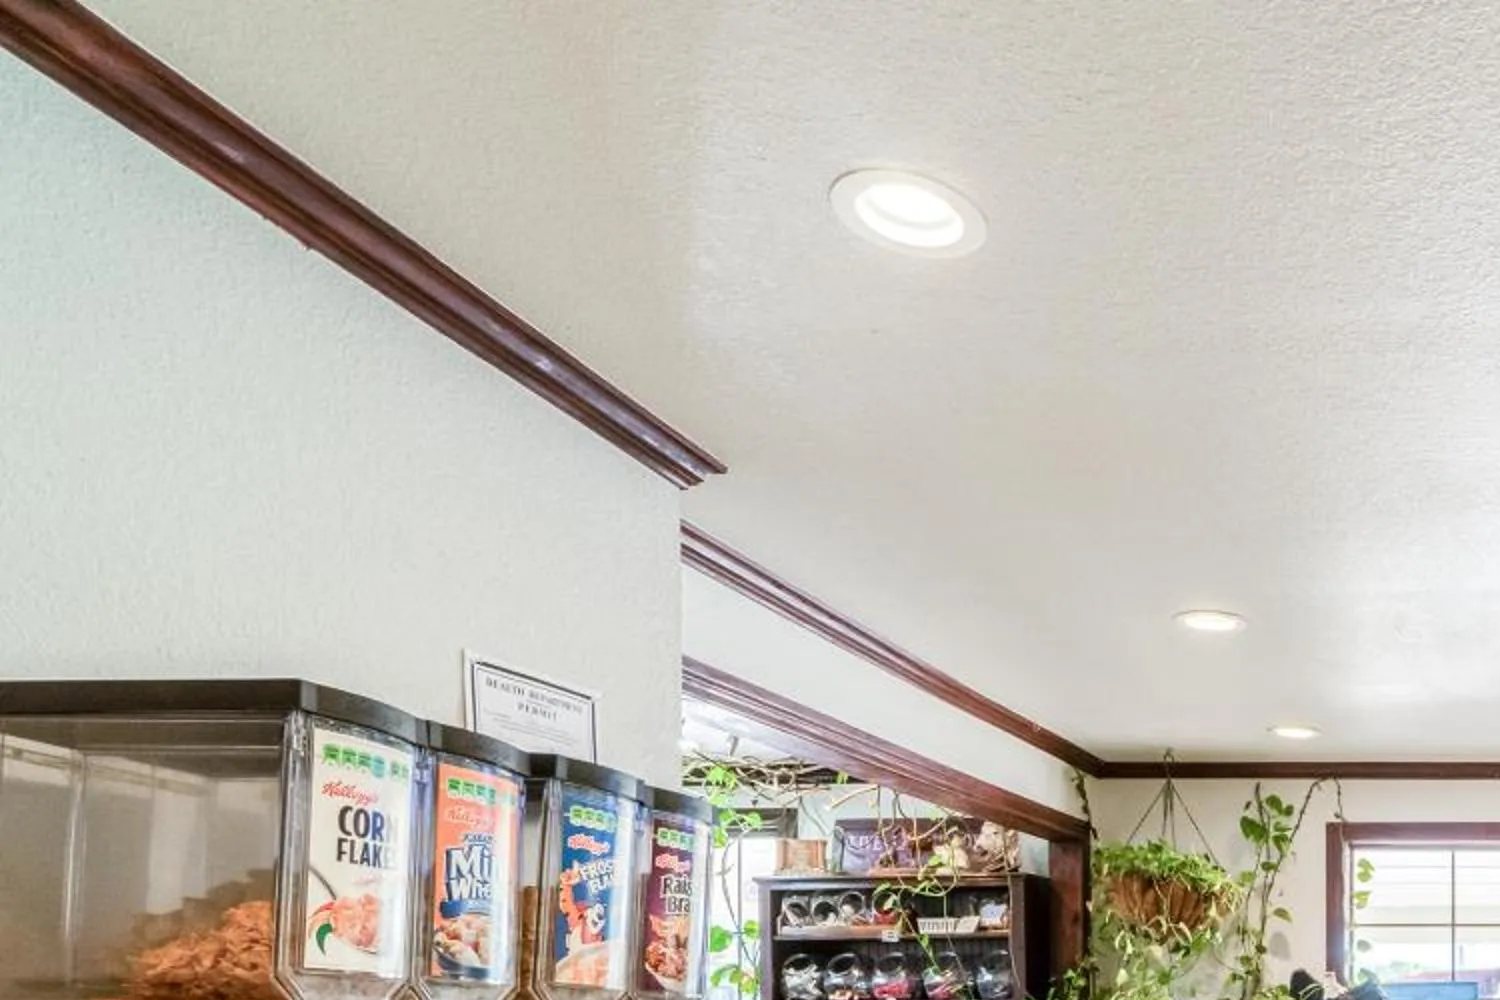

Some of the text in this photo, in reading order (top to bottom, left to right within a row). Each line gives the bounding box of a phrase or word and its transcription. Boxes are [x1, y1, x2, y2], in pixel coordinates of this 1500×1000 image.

[336, 836, 398, 869] FLAKE
[446, 845, 492, 880] Mi
[659, 874, 693, 898] Rais
[665, 895, 691, 915] Bra
